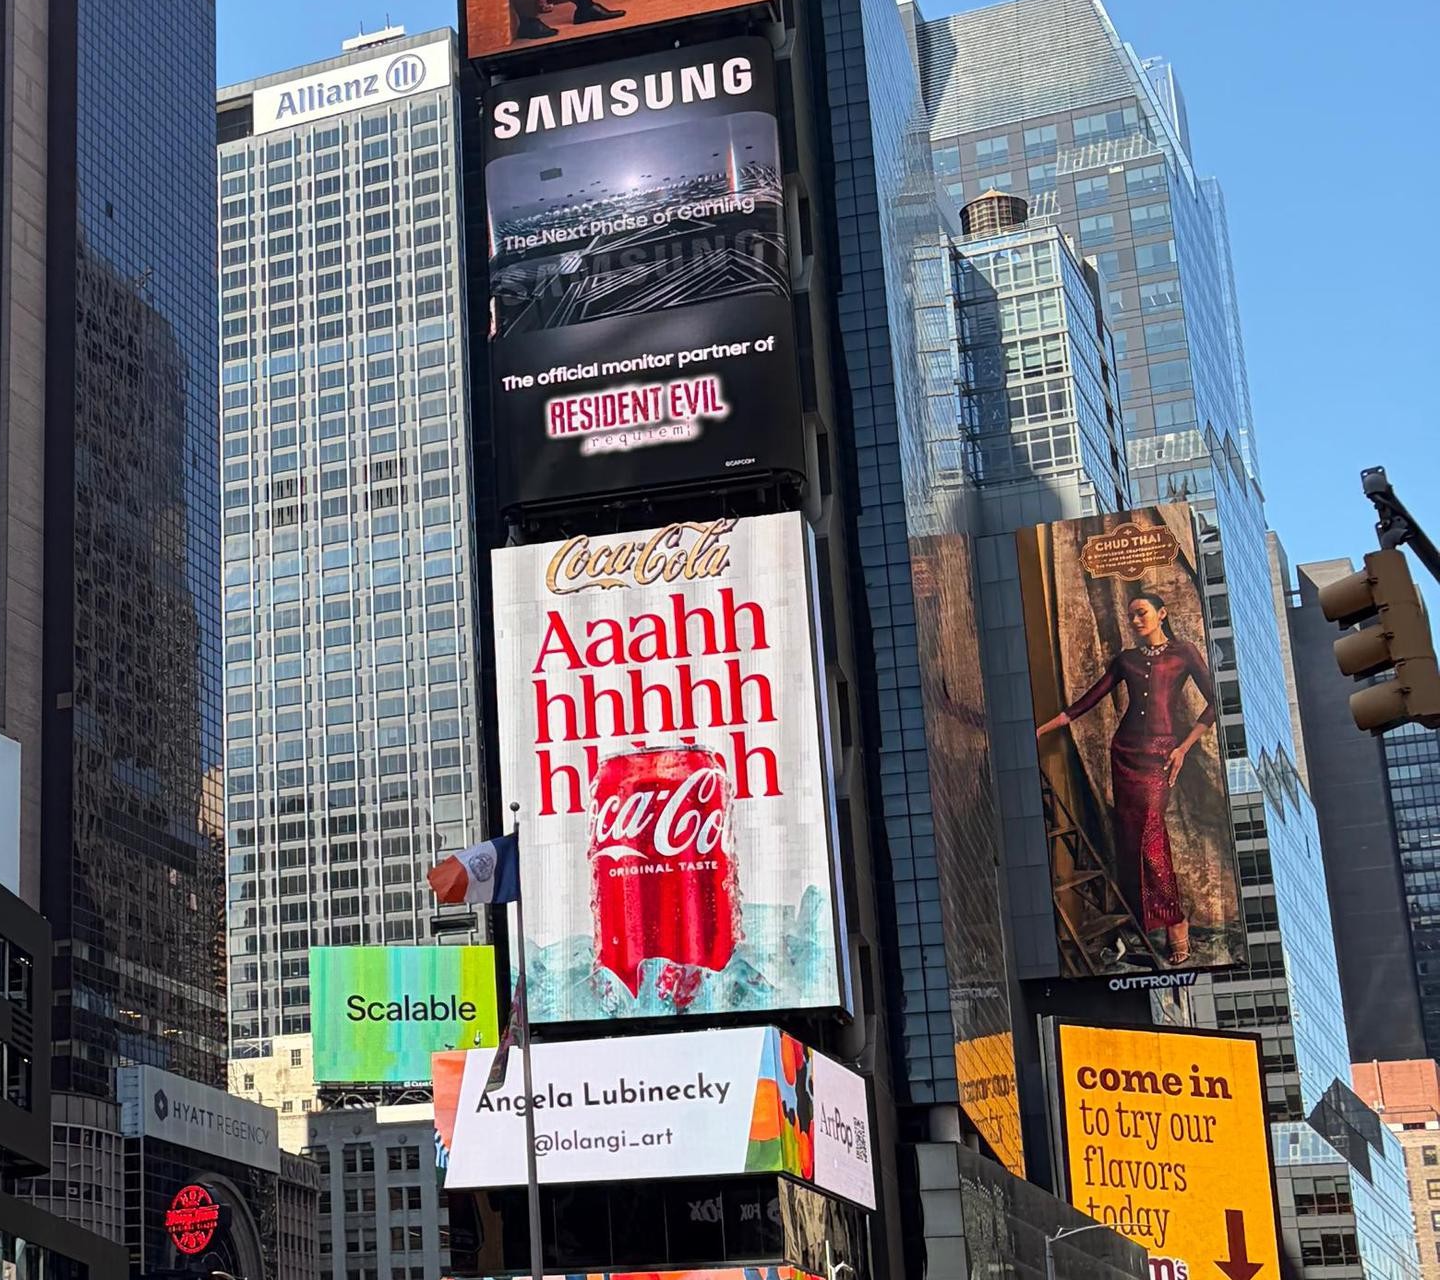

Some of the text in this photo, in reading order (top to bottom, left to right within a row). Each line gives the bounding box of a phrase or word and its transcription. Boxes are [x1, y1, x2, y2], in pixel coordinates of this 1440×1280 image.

[276, 74, 379, 120] Allianz
[493, 57, 753, 140] SAMSUNG
[504, 196, 756, 253] The Next Phase of Gaming
[502, 335, 775, 394] The official monitor partner of
[550, 376, 724, 435] RESIDENT EVIL
[545, 518, 738, 594] Coca-Cola
[1095, 534, 1161, 551] CHUD THAI
[532, 587, 771, 673] Aaahh
[533, 659, 778, 744] hhhhh
[608, 859, 719, 878] ORIGINAL TASTE
[347, 994, 476, 1022] Scalable
[475, 1073, 731, 1117] Angela Lubinecky
[1076, 1064, 1232, 1100] come in
[173, 1099, 270, 1144] HYATT REGENCY
[533, 1128, 673, 1157] @lolangi_art
[820, 1102, 854, 1155] ArtPop
[1080, 1098, 1216, 1150] to try our
[1084, 1144, 1187, 1192] flavors
[1085, 1194, 1171, 1249] today
